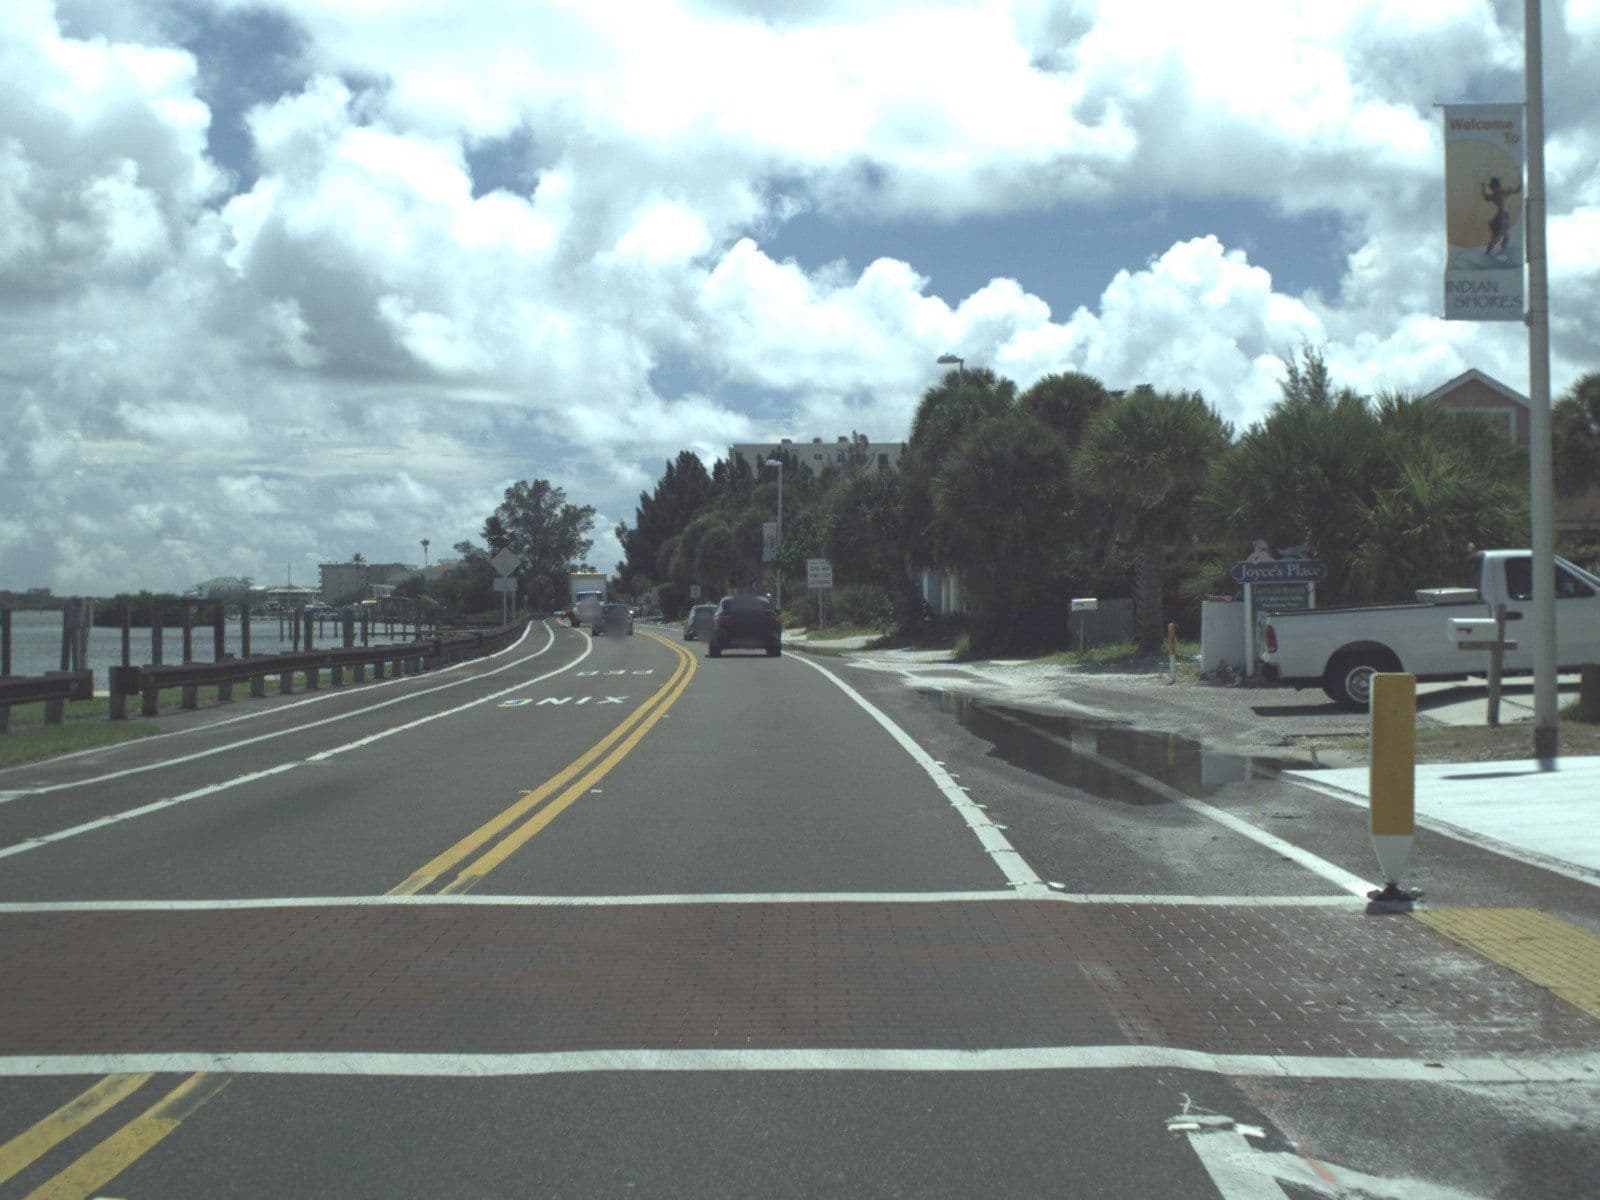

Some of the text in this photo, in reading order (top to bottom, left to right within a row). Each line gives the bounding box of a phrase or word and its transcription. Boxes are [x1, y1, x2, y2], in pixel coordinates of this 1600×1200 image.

[1450, 117, 1514, 131] Welcome
[1446, 280, 1499, 294] INDIAN
[1454, 295, 1523, 309] SHORES
[1240, 562, 1321, 581] Joyce's Place
